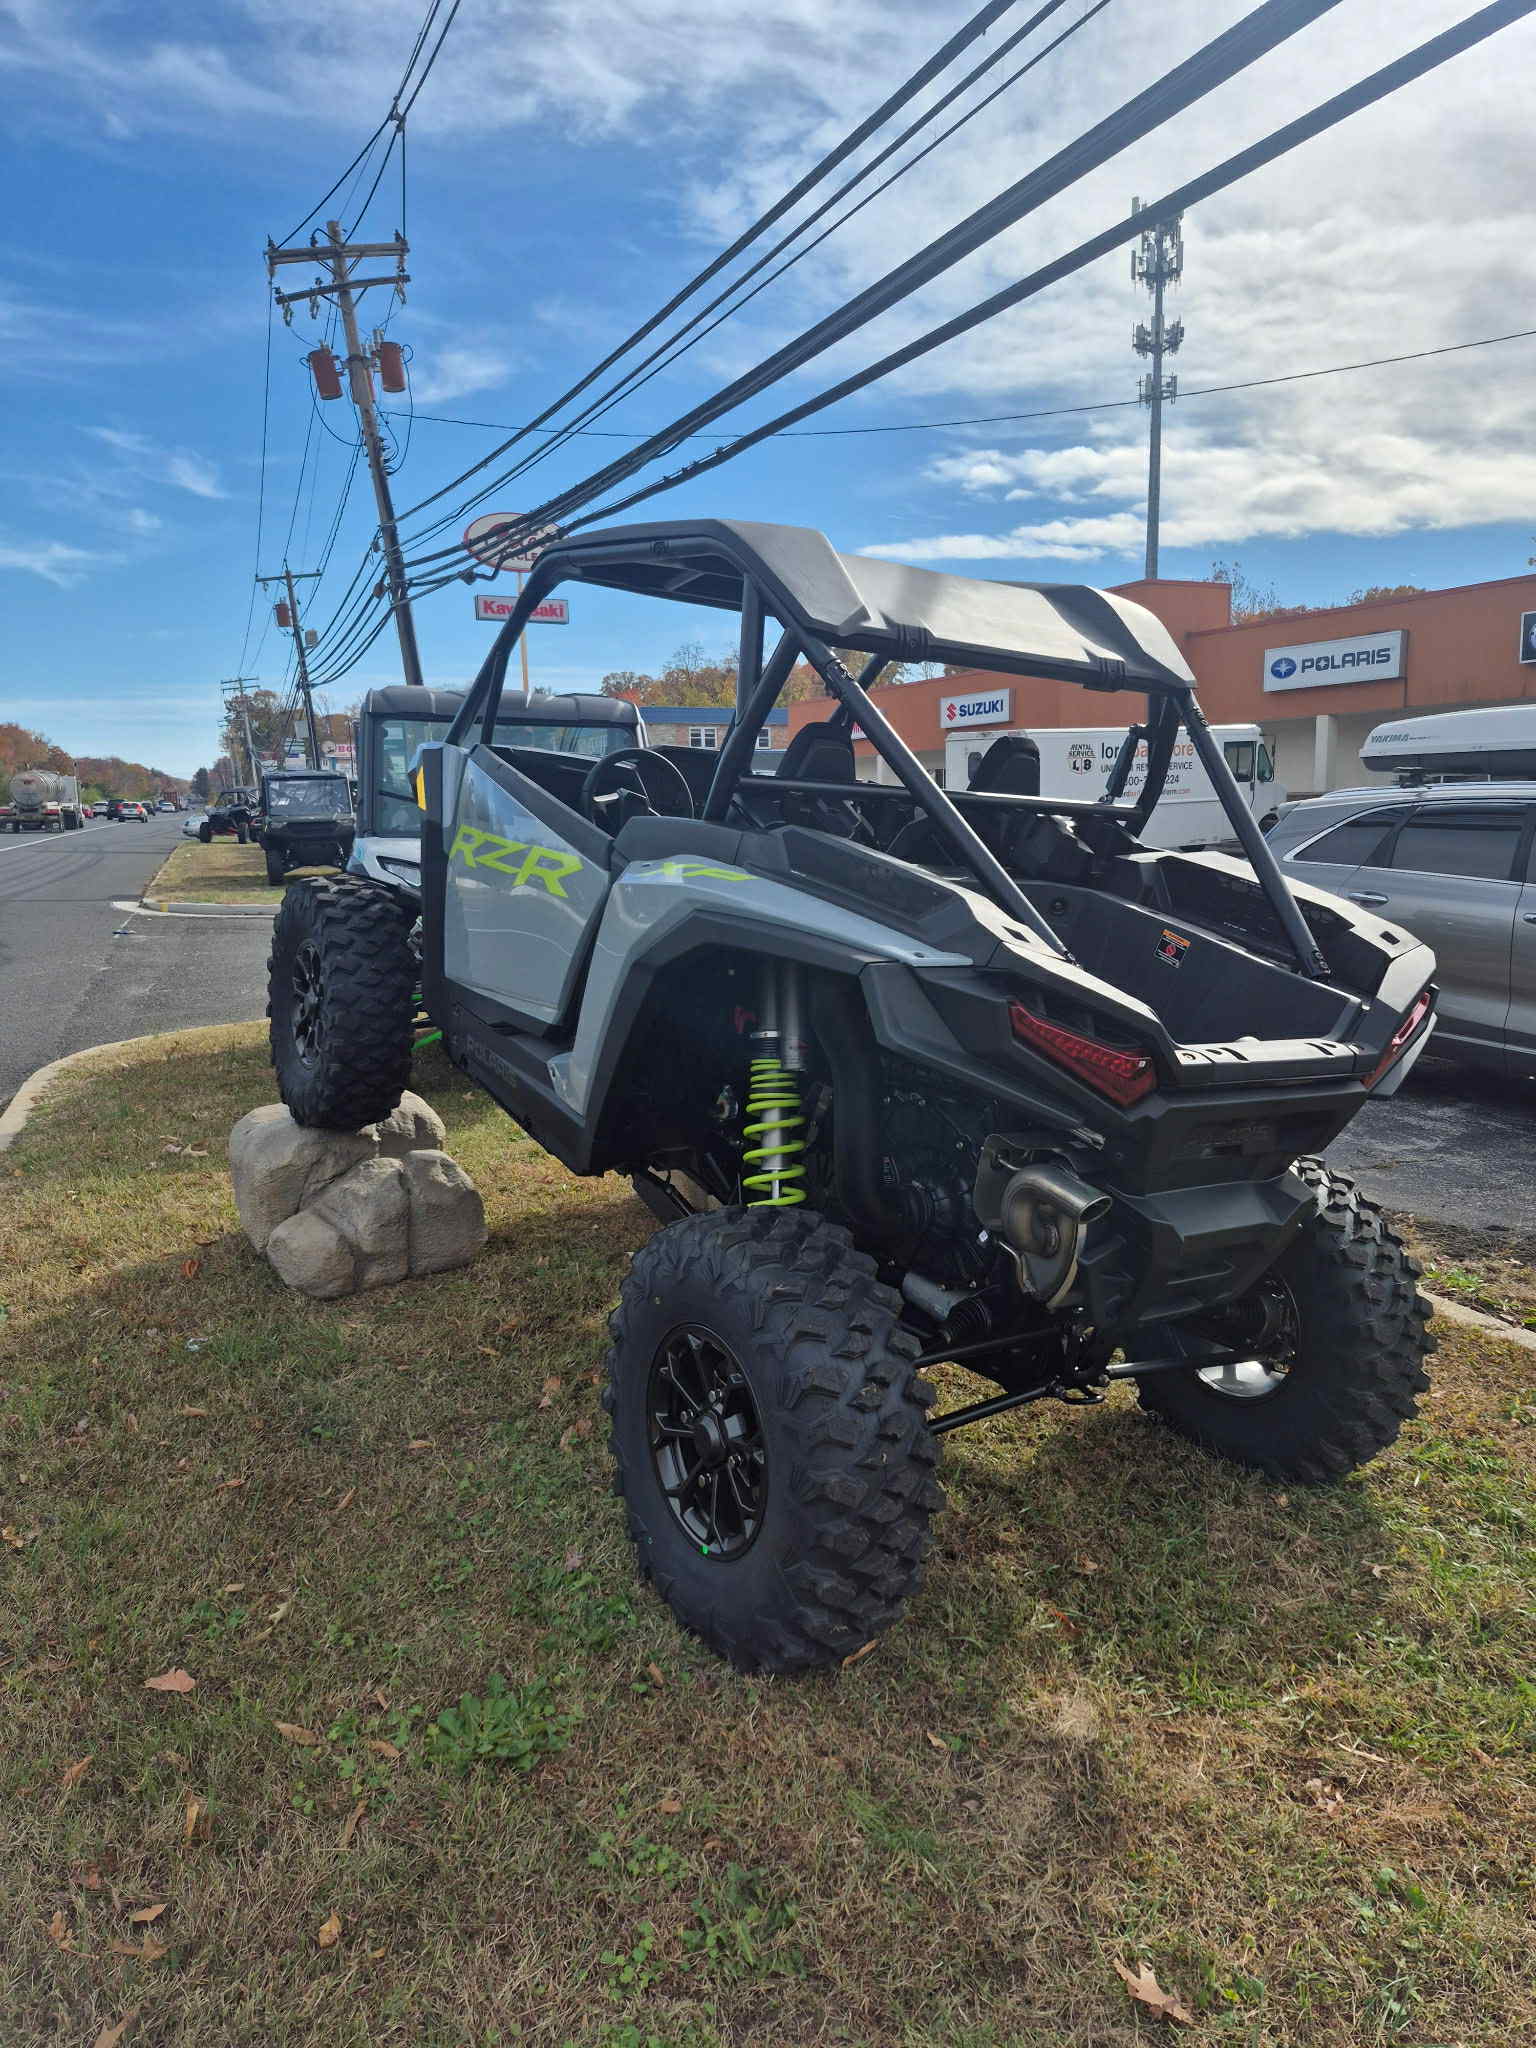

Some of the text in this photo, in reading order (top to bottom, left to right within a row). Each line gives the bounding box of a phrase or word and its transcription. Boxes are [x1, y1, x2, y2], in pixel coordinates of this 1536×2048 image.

[1301, 647, 1391, 674] POLARIS
[959, 699, 1003, 717] SUZUKI
[1168, 761, 1193, 770] ERVICE
[449, 824, 583, 899] RZR
